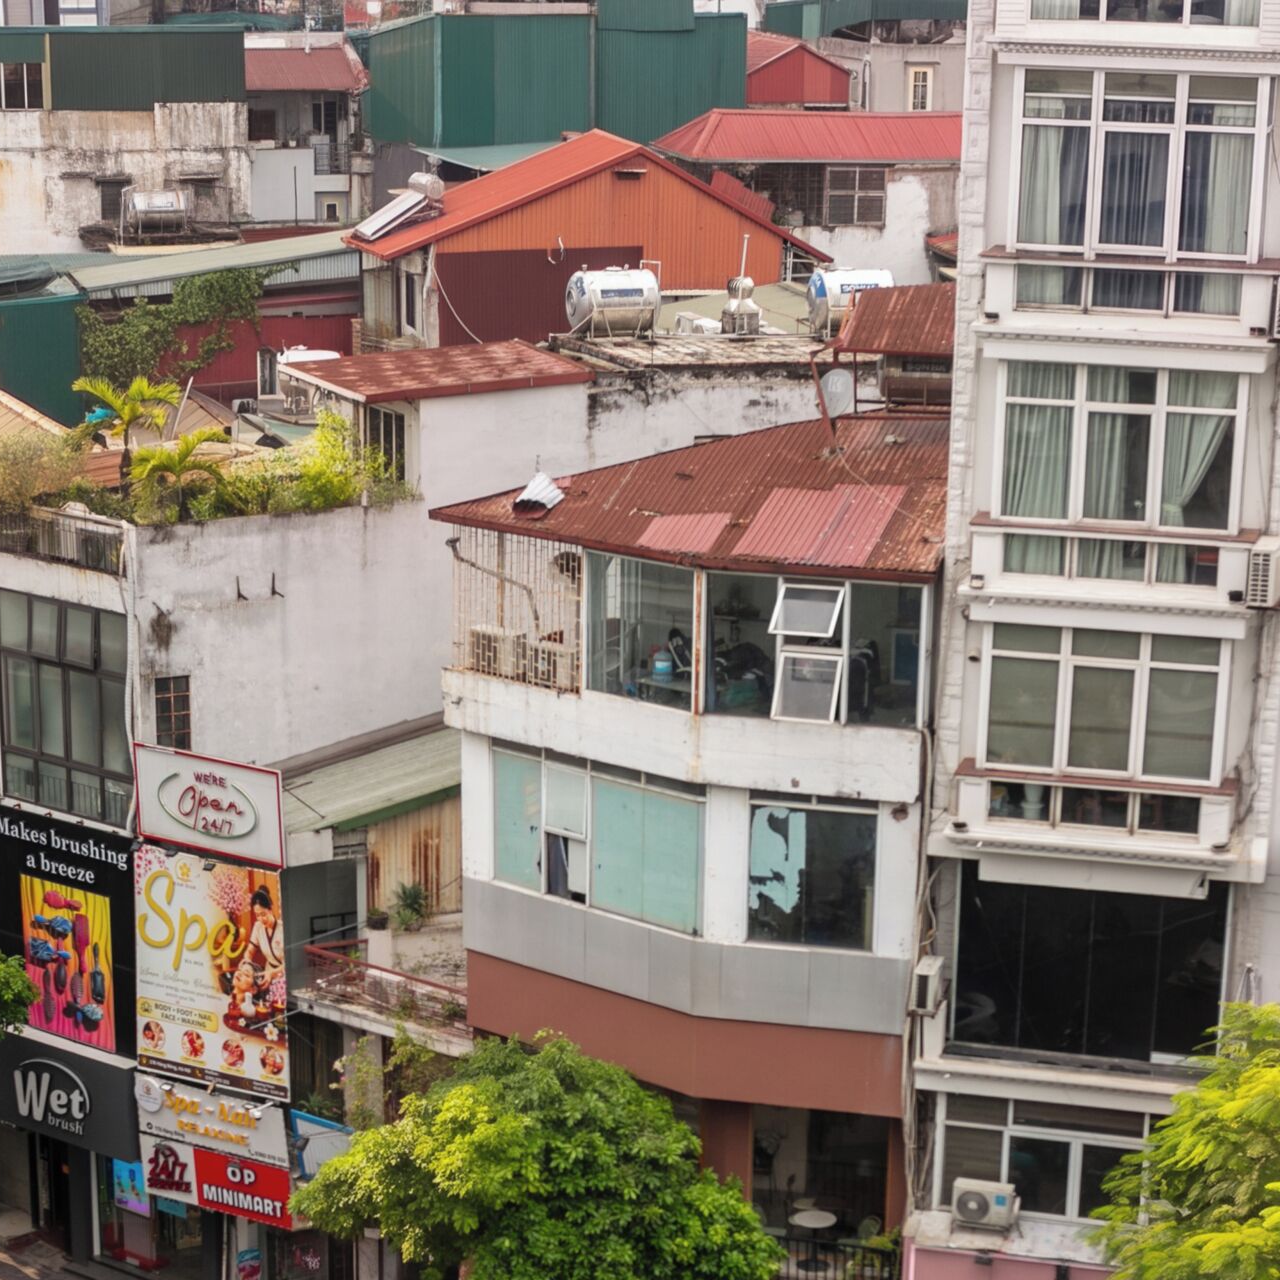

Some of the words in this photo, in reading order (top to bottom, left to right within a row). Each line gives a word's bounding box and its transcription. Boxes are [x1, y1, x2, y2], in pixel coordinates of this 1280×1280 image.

[193, 771, 227, 789] WE'RE
[178, 785, 244, 832] Open
[201, 816, 233, 834] 24/7
[51, 829, 128, 871] brushing
[26, 854, 36, 869] a
[40, 852, 96, 884] breeze
[138, 869, 246, 972] Spa
[13, 1068, 85, 1123] Wet
[163, 1091, 201, 1116] Spa
[47, 1112, 84, 1136] brush
[176, 1118, 249, 1146] RELAXING
[148, 1148, 188, 1181] 24/7
[226, 1164, 256, 1185] OP
[202, 1183, 283, 1218] MINIMART
